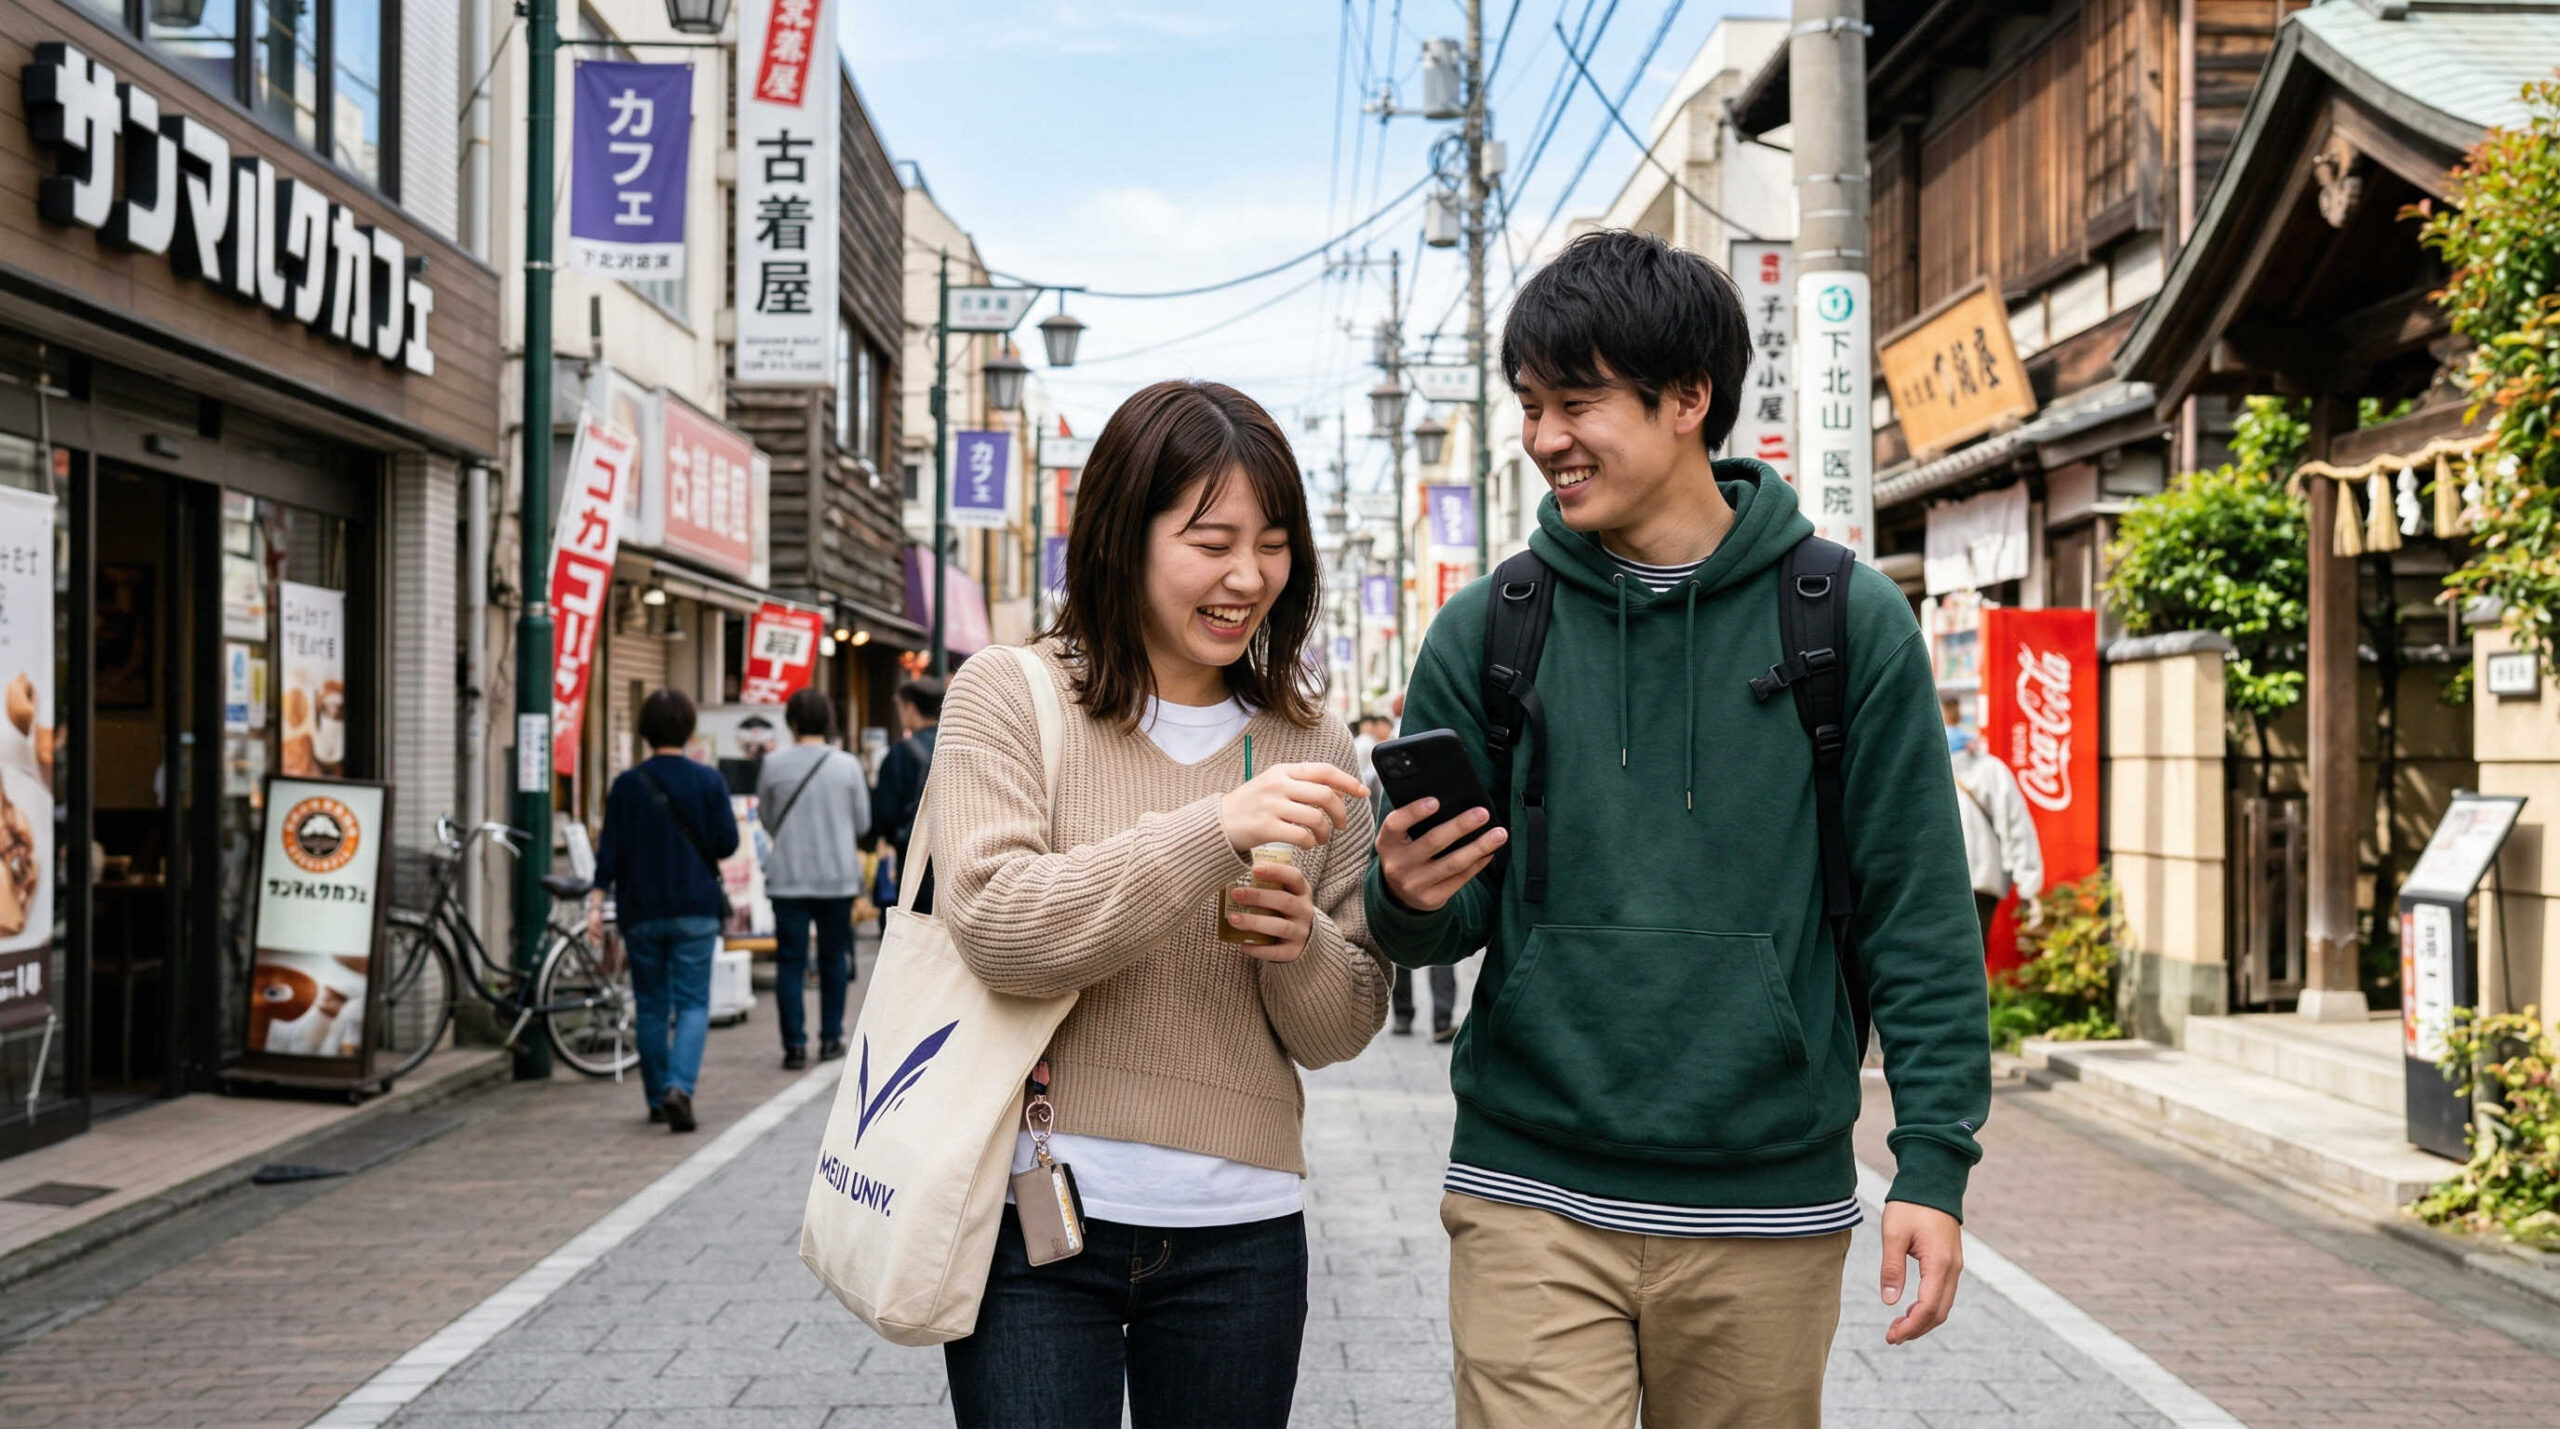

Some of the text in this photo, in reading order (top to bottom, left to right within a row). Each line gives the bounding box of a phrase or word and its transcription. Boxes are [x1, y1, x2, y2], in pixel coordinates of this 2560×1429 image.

[607, 89, 653, 225] カフェ
[54, 43, 434, 376] サンマルクカフェ
[756, 129, 813, 315] 古着屋
[969, 441, 994, 502] カフェ
[268, 878, 367, 903] サンマルクカフェ
[819, 1149, 895, 1217] MEIJI UNIV.
